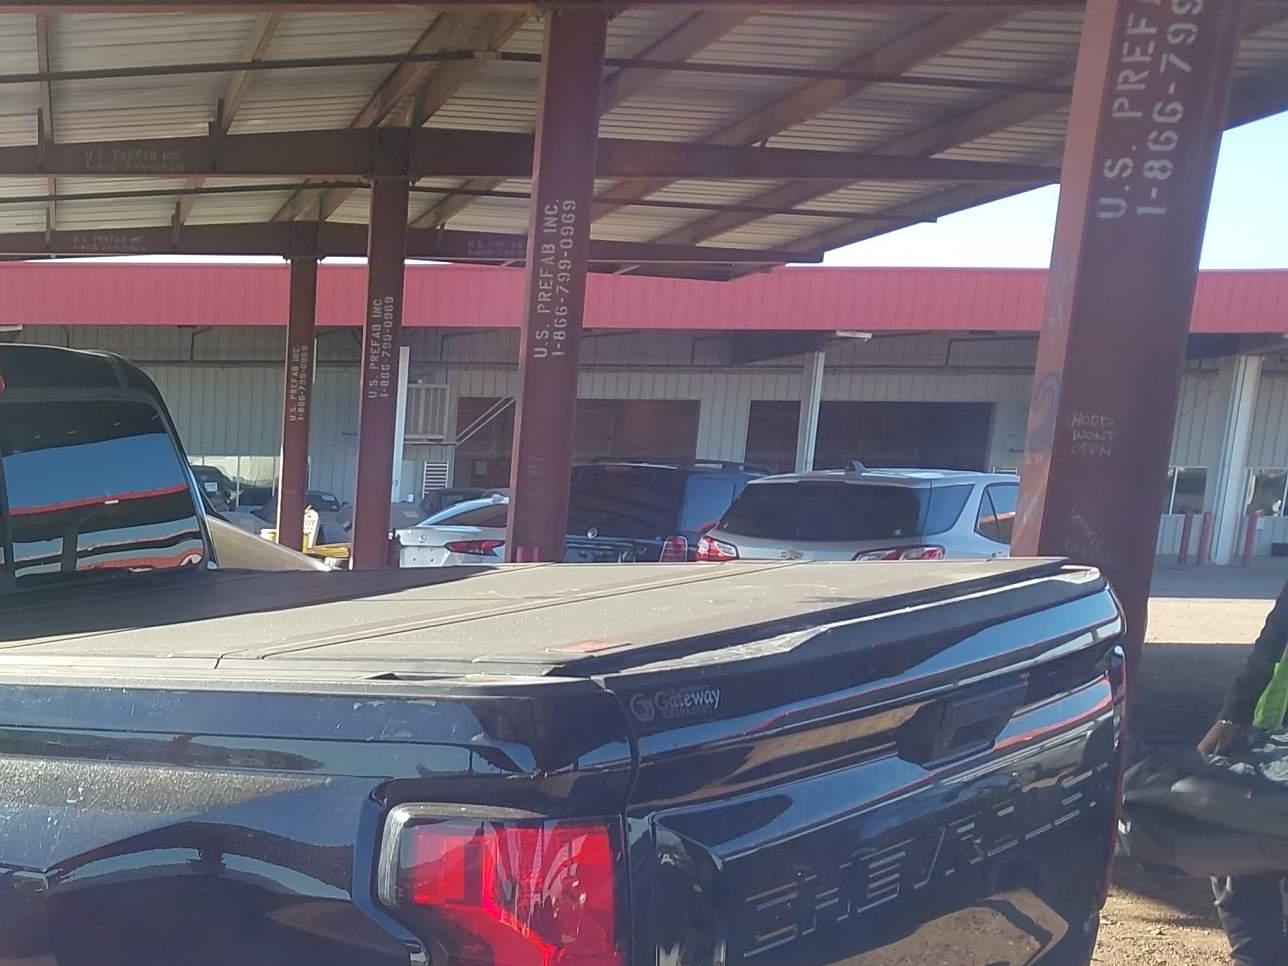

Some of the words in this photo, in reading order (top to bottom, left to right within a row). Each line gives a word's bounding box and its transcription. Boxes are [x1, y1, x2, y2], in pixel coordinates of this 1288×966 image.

[1096, 145, 1137, 219] U.S.
[544, 199, 560, 233] INC.
[537, 243, 556, 313] PREFAB
[552, 200, 577, 356] 1-866-799-0969
[369, 324, 381, 370] PREFAB
[533, 324, 550, 358] U.S.
[1071, 413, 1114, 427] HOOD
[1072, 430, 1113, 441] WONT
[654, 688, 720, 710] Gateway
